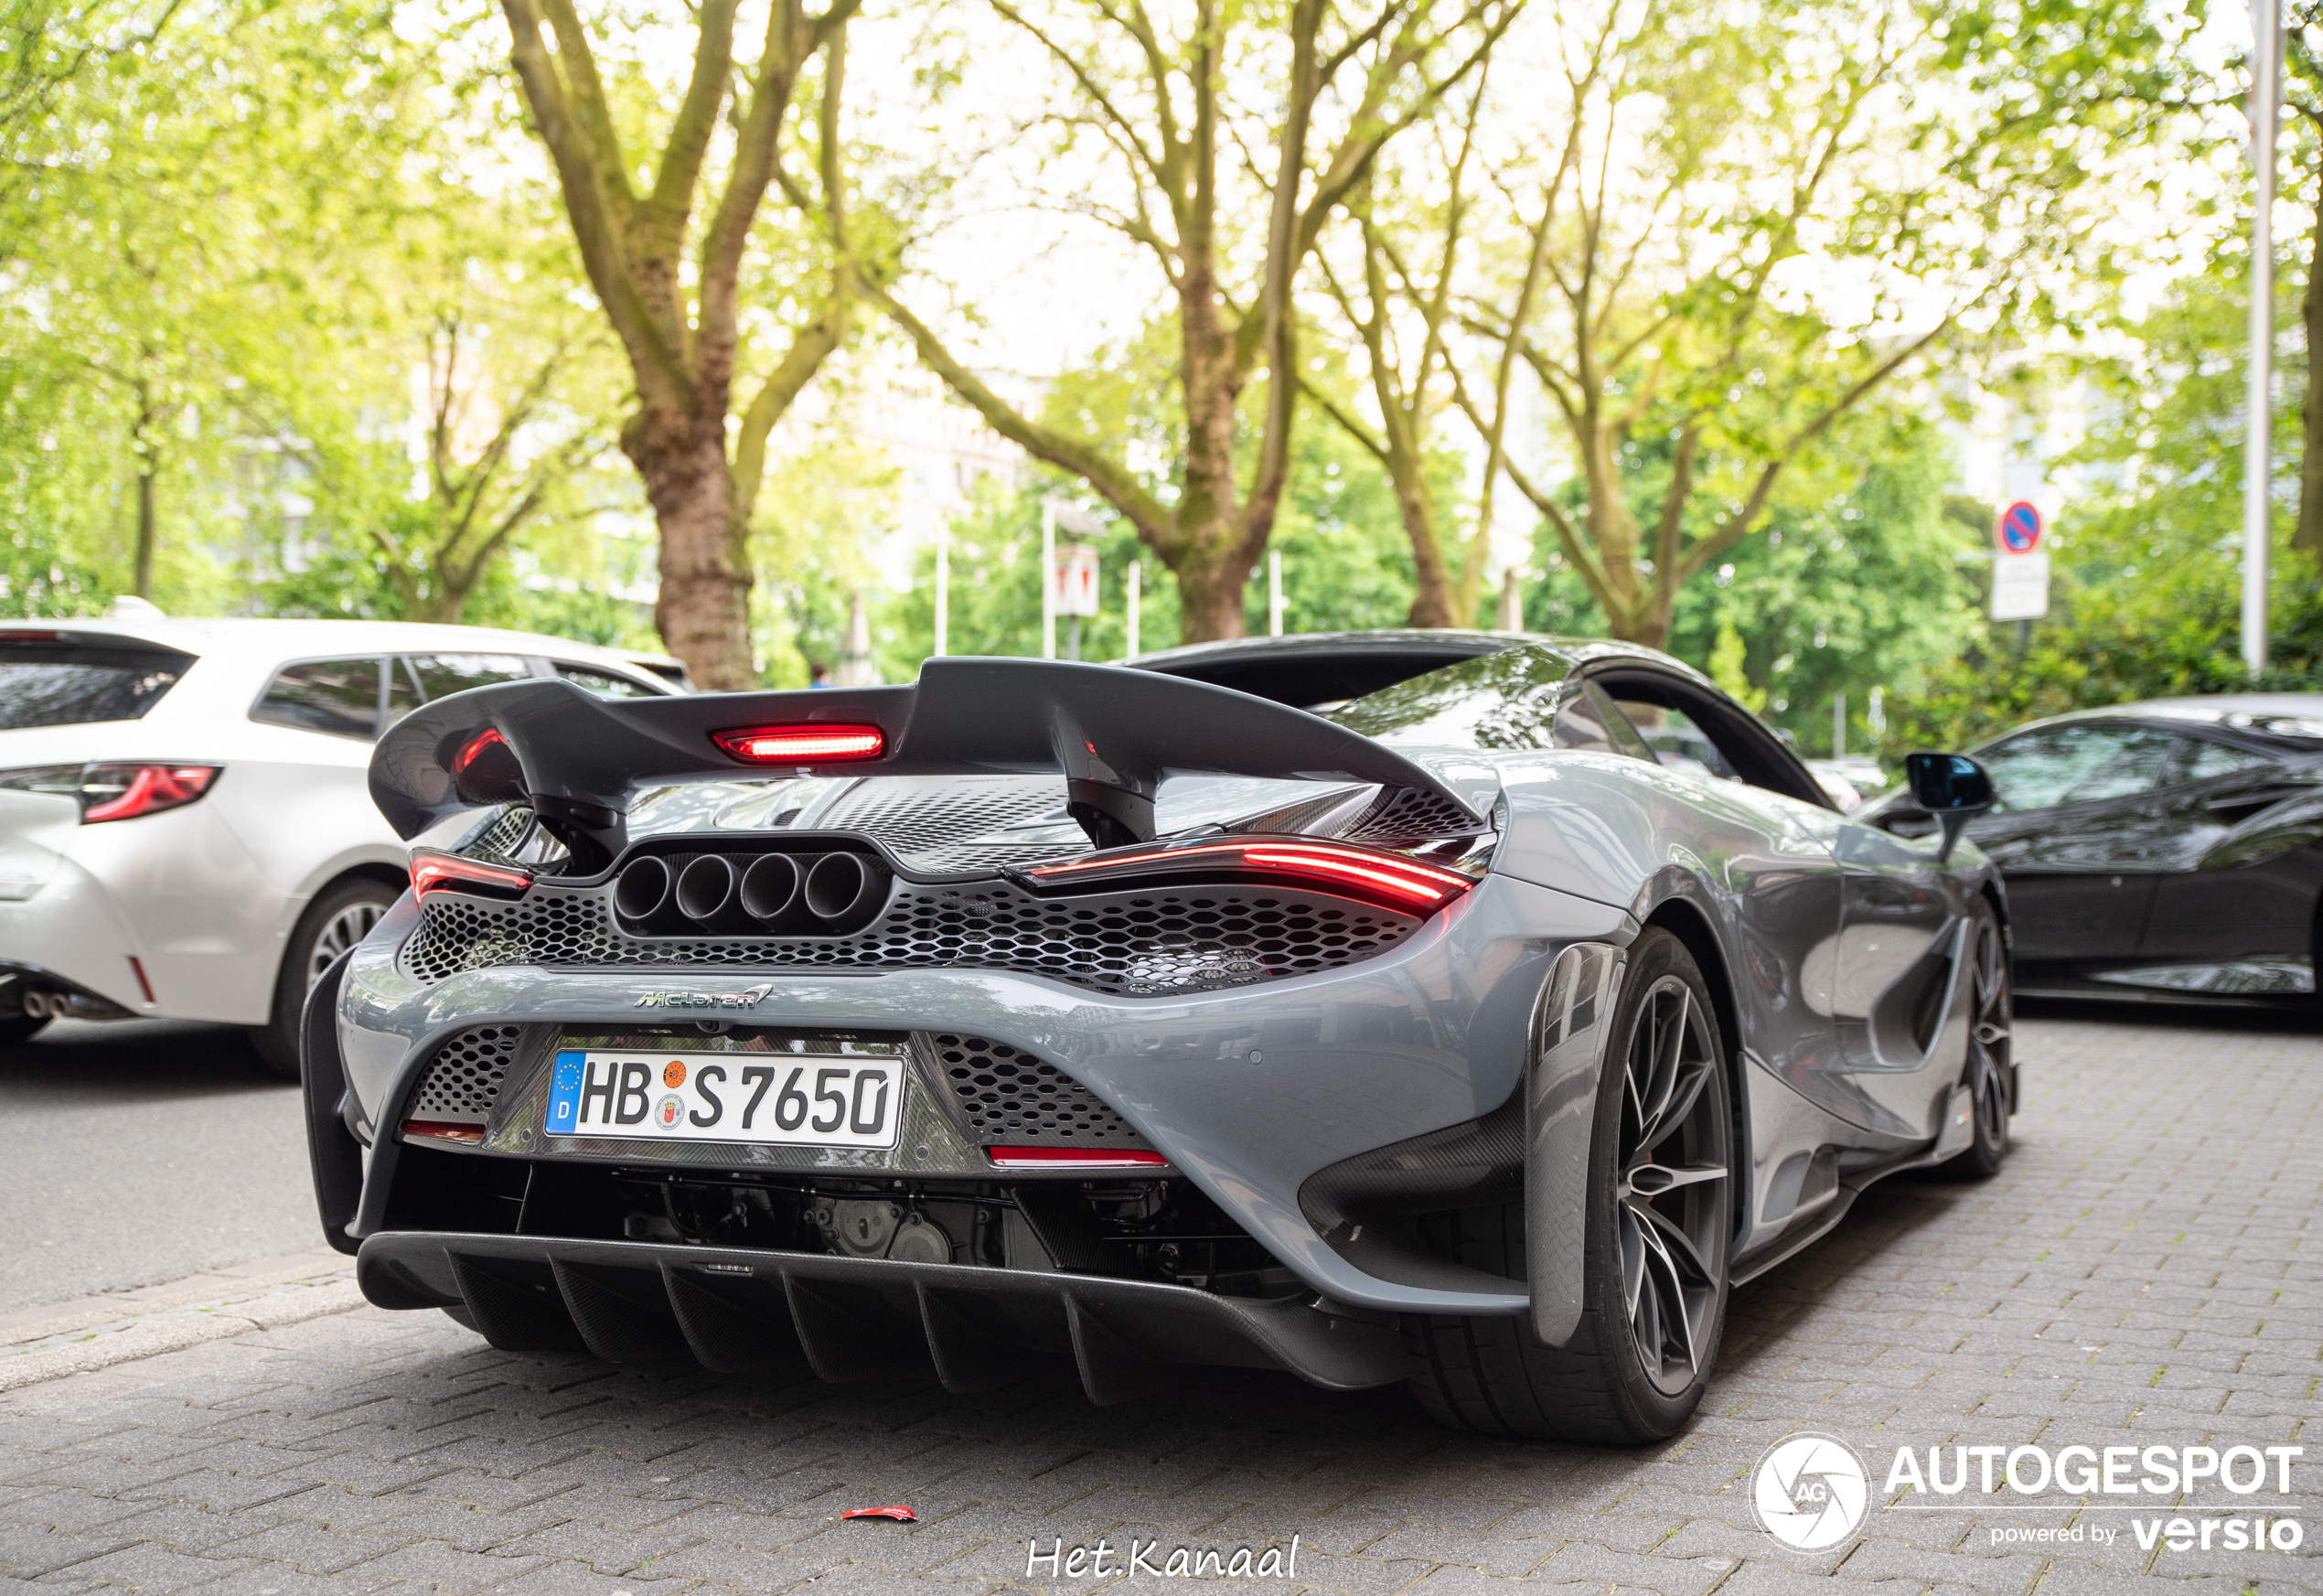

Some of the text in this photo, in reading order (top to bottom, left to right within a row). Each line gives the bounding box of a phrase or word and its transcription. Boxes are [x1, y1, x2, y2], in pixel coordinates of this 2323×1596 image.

[634, 991, 755, 1009] McLaren
[578, 1061, 652, 1125] HB
[689, 1065, 728, 1128] S
[741, 1066, 889, 1134] 7650
[557, 1101, 570, 1119] D
